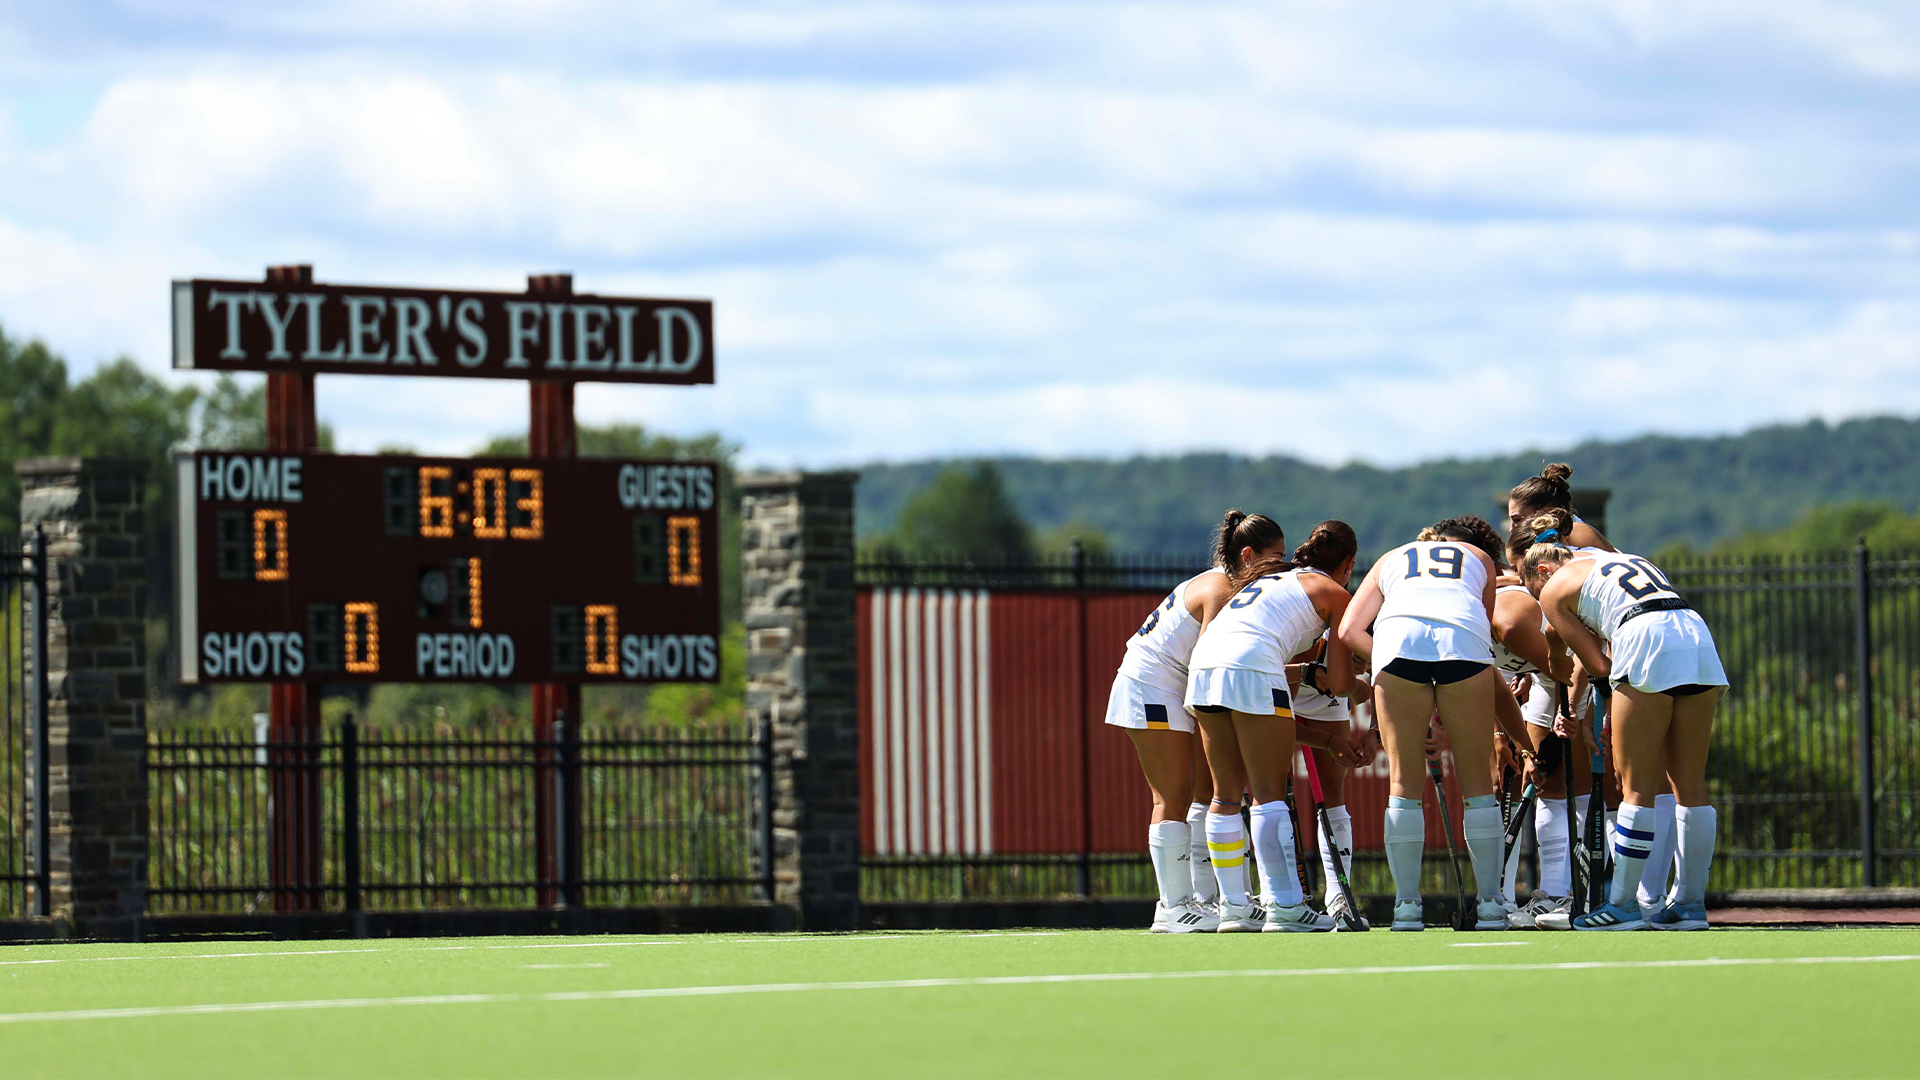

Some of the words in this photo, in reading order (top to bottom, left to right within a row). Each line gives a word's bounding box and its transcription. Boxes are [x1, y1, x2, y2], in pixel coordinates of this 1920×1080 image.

[207, 288, 488, 367] TYLER'S
[503, 300, 703, 374] FIELD
[202, 455, 302, 500] HOME
[619, 463, 714, 510] GUESTS
[418, 466, 544, 539] 6:03
[254, 508, 289, 581] 0
[667, 515, 701, 586] 0
[1403, 546, 1465, 580] 19
[469, 557, 482, 628] 1
[1230, 575, 1283, 609] 5
[1601, 558, 1673, 600] 20
[203, 632, 305, 677] SHOTS
[345, 602, 379, 673] 0
[417, 633, 515, 677] PERIOD
[585, 604, 619, 674] 0
[621, 634, 717, 678] SHOTS
